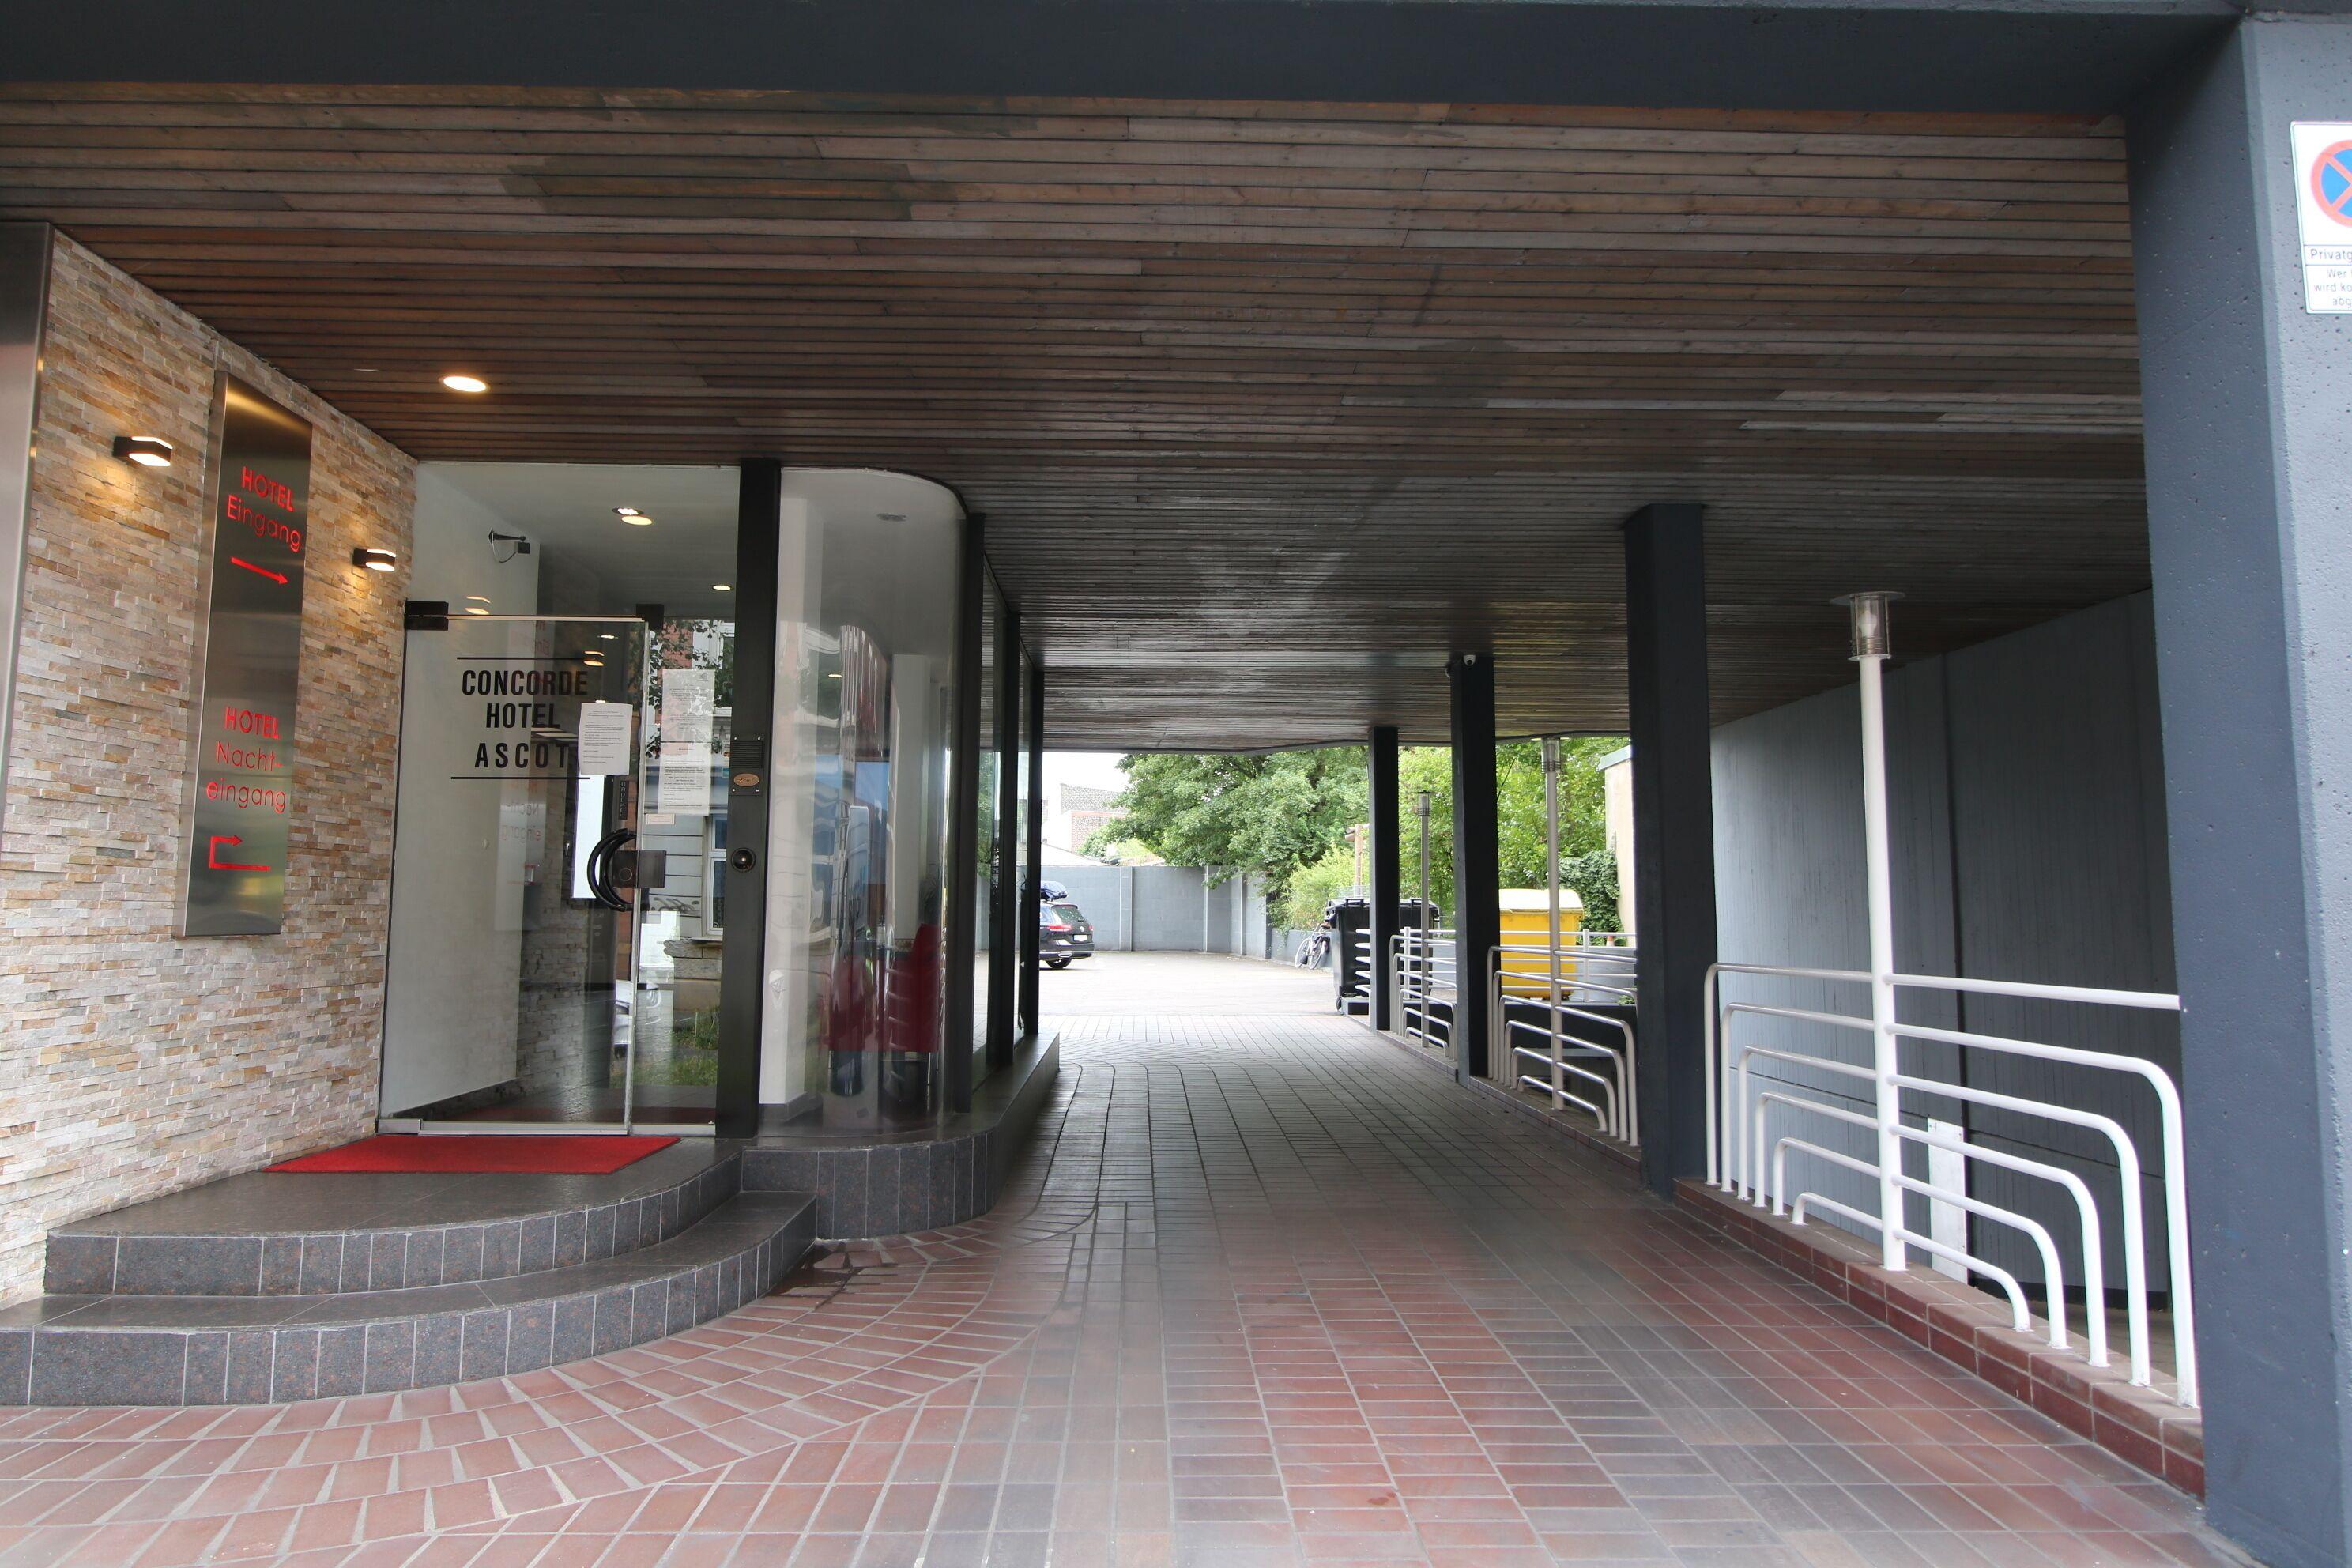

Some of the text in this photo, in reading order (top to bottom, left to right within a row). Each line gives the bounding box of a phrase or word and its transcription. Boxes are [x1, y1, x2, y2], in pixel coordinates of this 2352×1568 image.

[2310, 248, 2352, 263] Privatg
[2327, 269, 2347, 278] Wer
[2314, 283, 2337, 292] wird
[240, 466, 296, 513] HOTEL
[226, 494, 303, 554] Eingang
[462, 669, 589, 696] CONCORDE
[224, 706, 281, 740] HOTEL
[485, 703, 561, 729] HOTEL
[216, 741, 283, 771] Nacht-
[474, 742, 570, 769] ASCOT
[206, 778, 288, 814] eingang
